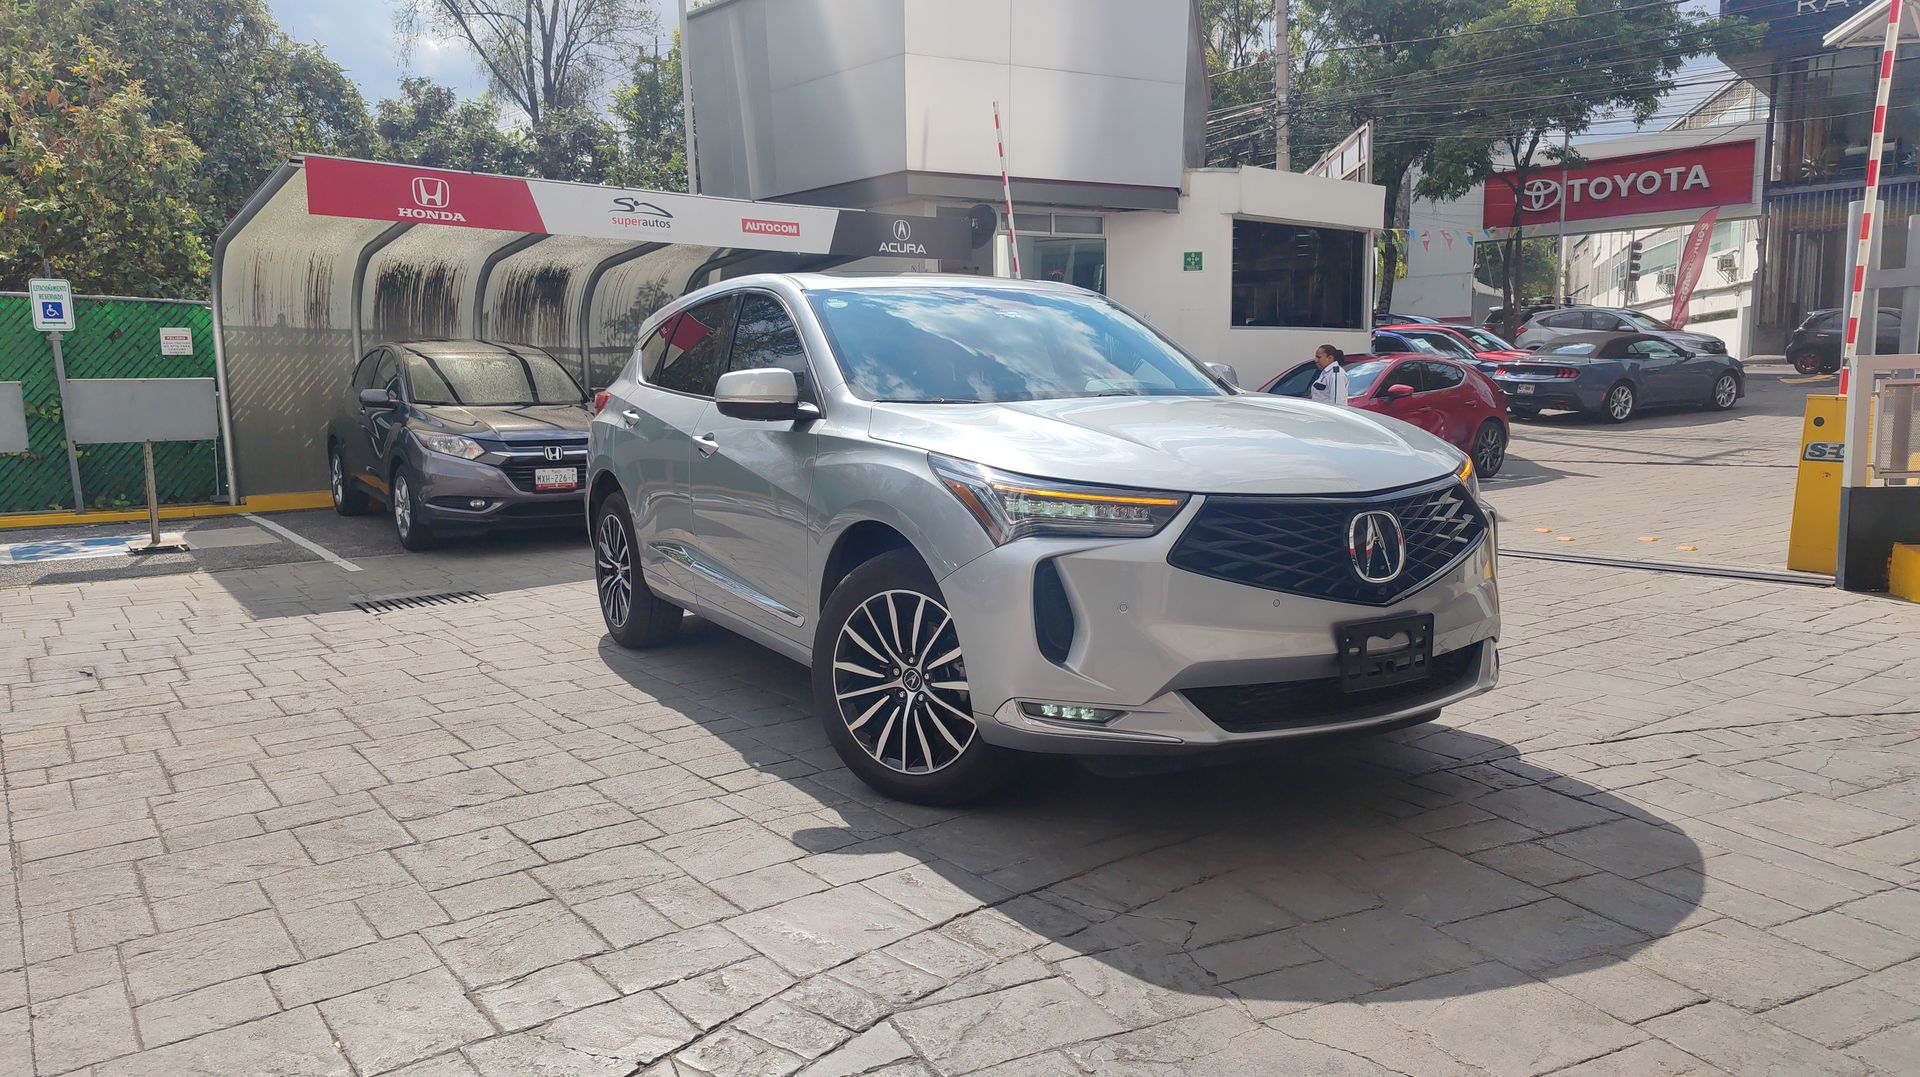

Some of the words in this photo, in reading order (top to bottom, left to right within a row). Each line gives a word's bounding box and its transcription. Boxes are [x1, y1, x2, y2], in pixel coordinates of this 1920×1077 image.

[1567, 164, 1711, 203] TOYOTA
[397, 207, 467, 222] HONDA
[611, 216, 671, 229] superautos
[745, 221, 798, 234] AUTOCOM
[879, 242, 927, 255] ACURA
[38, 293, 64, 301] RESERVADO
